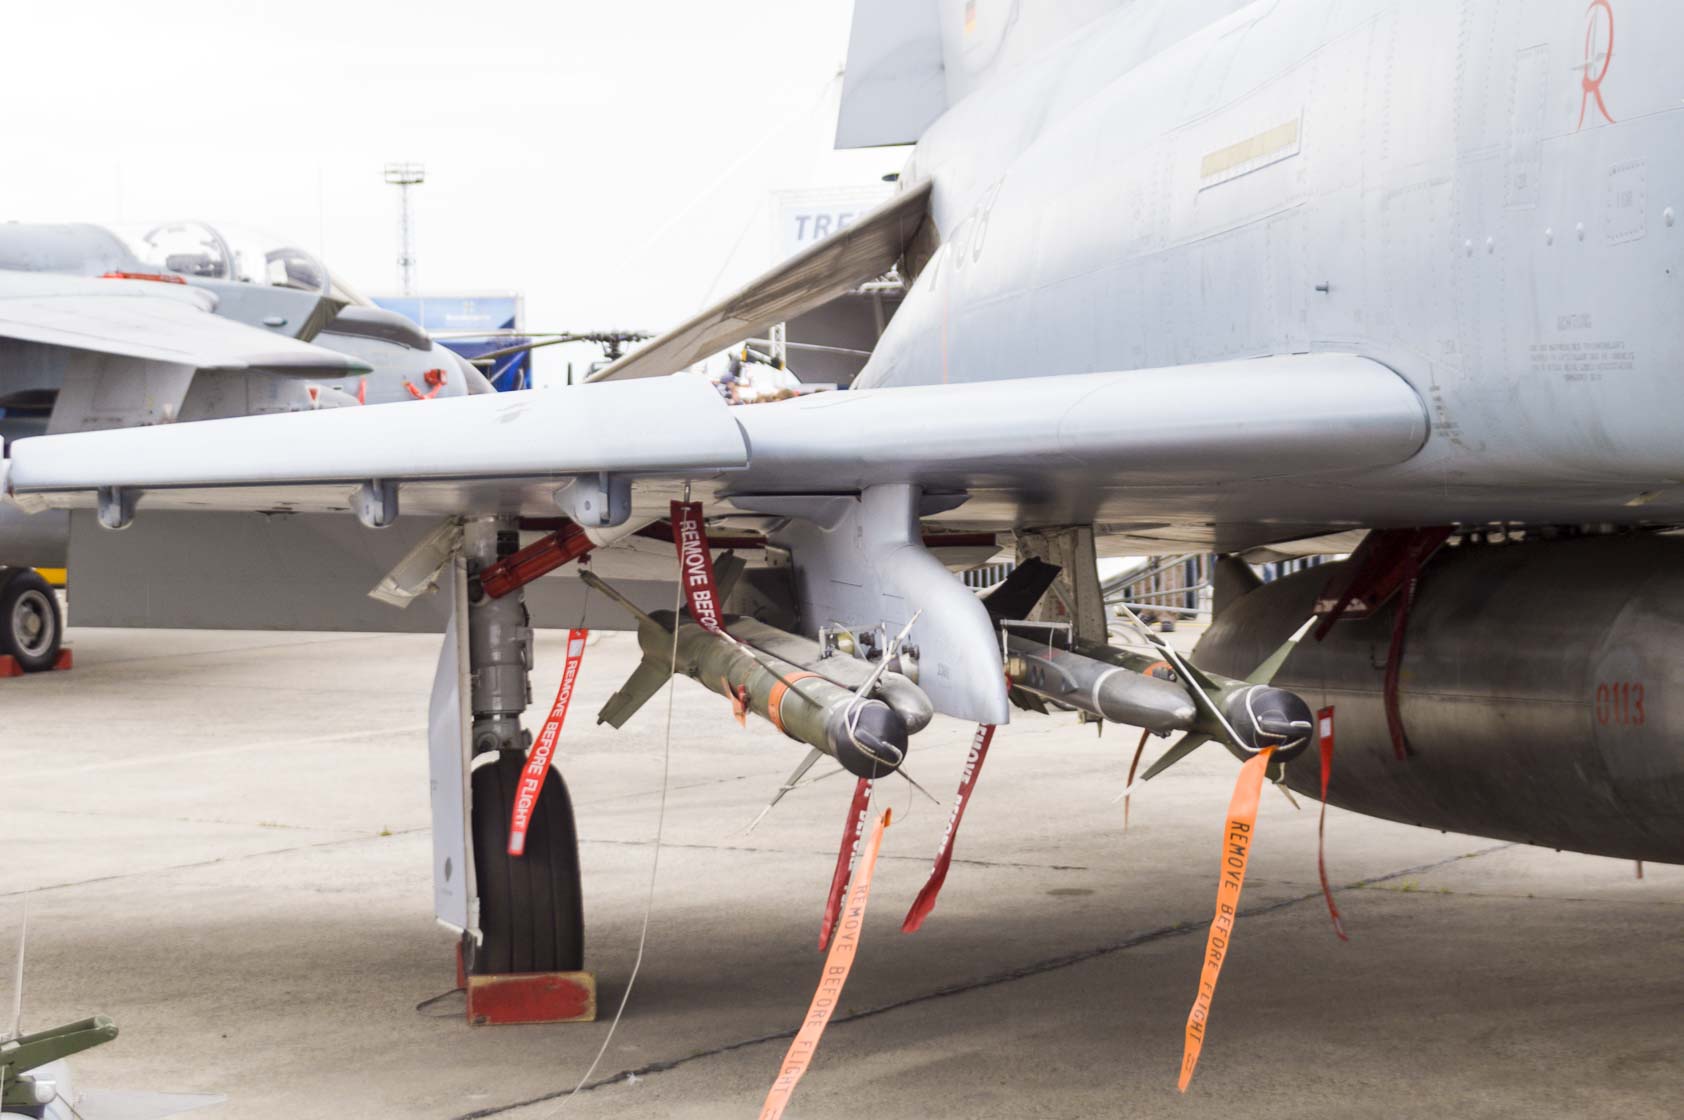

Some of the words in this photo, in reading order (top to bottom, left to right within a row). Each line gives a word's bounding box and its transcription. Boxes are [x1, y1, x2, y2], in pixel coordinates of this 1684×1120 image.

[680, 520, 708, 587] REMOVE
[552, 660, 578, 717] REMOVE
[1596, 681, 1646, 727] 0113
[528, 721, 559, 776] BEFORE
[515, 778, 537, 827] FLIGHT
[1225, 820, 1251, 891] REMOVE
[836, 884, 869, 952] REMOVE
[1208, 903, 1234, 970] BEFORE
[807, 966, 846, 1028] BEFORE
[1188, 982, 1213, 1044] FLIGHT
[773, 1040, 813, 1094] FLIGHT
